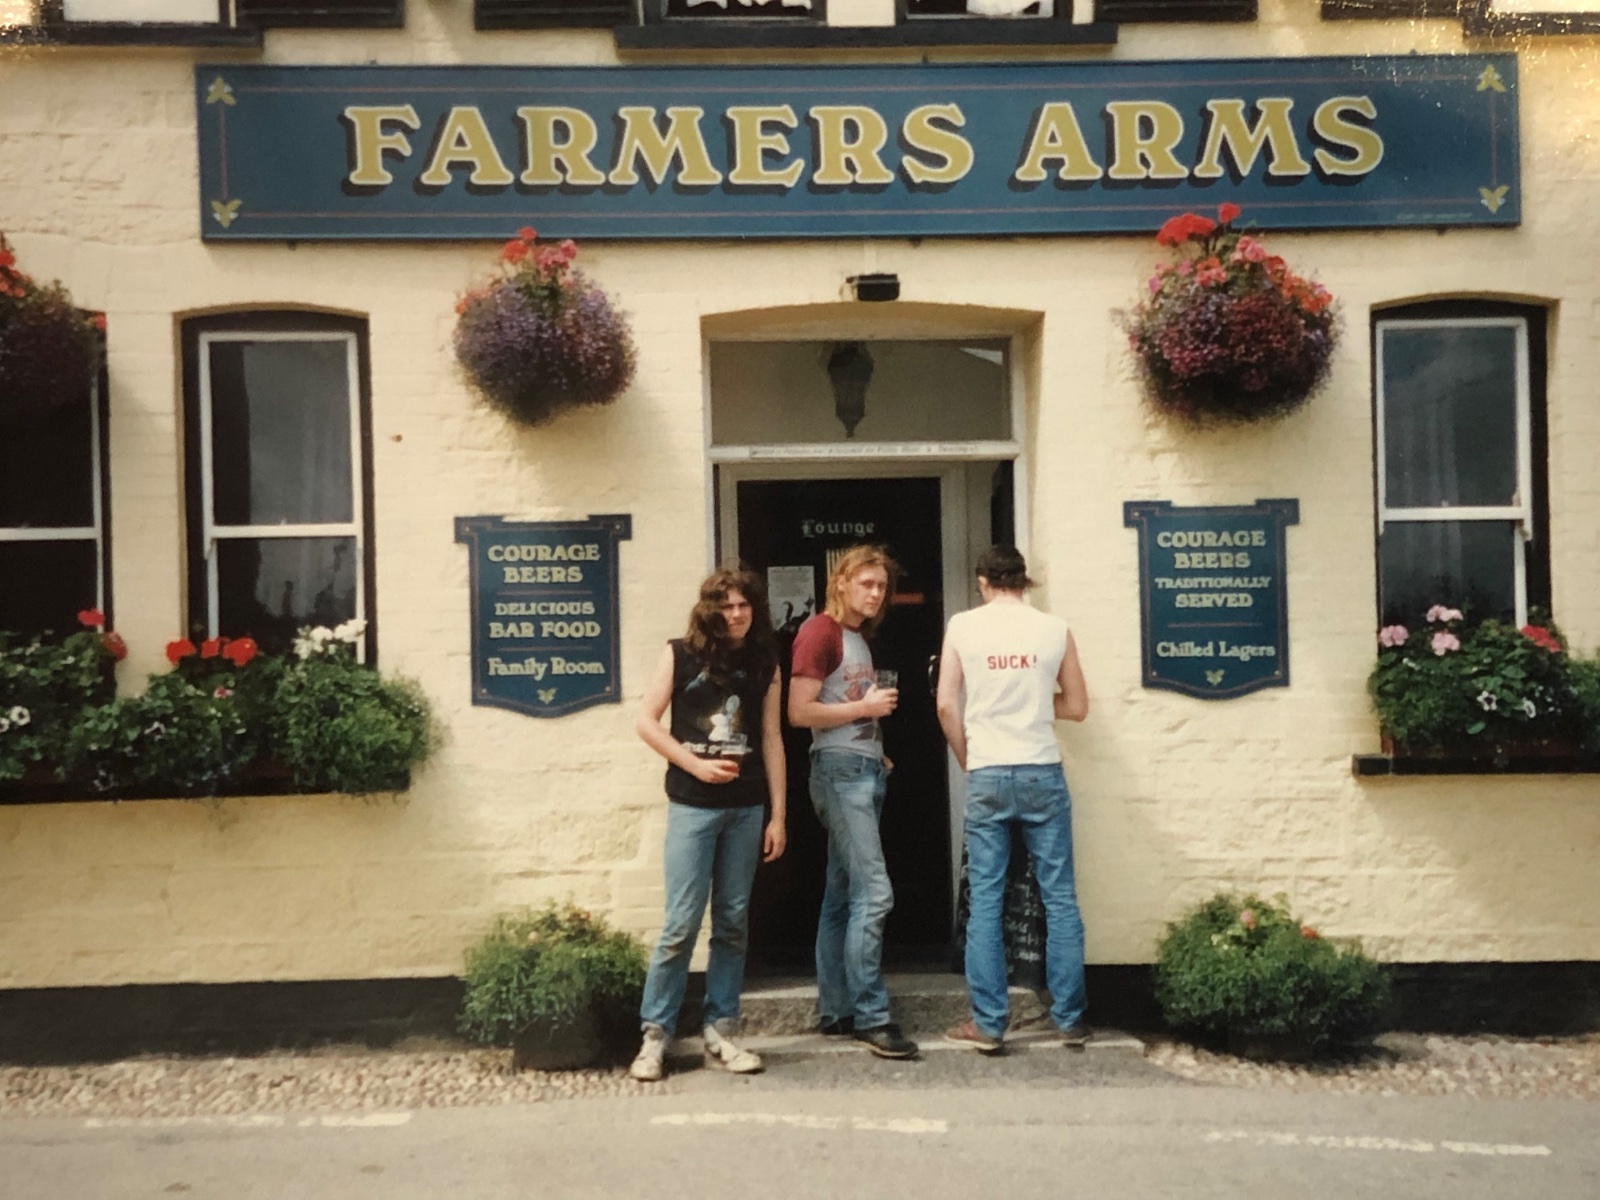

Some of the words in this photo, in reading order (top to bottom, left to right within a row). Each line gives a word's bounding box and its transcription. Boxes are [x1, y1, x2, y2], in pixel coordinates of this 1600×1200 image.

[342, 102, 975, 190] FARMERS
[1013, 96, 1384, 183] ARMS
[801, 519, 876, 538] Lounge
[1157, 530, 1267, 548] COURAGE
[487, 544, 601, 562] COURAGE
[1174, 552, 1251, 569] BEERS
[503, 566, 584, 583] BEERS
[1154, 576, 1272, 589] TRADITIONALLY
[494, 601, 596, 616] DELICIOUS
[1175, 593, 1254, 608] SERVED
[489, 622, 535, 638] BAR
[541, 621, 602, 638] FOOD
[1156, 641, 1215, 658] Chilled
[1219, 641, 1276, 662] Lagers
[488, 656, 548, 681] Family
[551, 656, 606, 675] Room
[987, 654, 1037, 670] SUCK!
